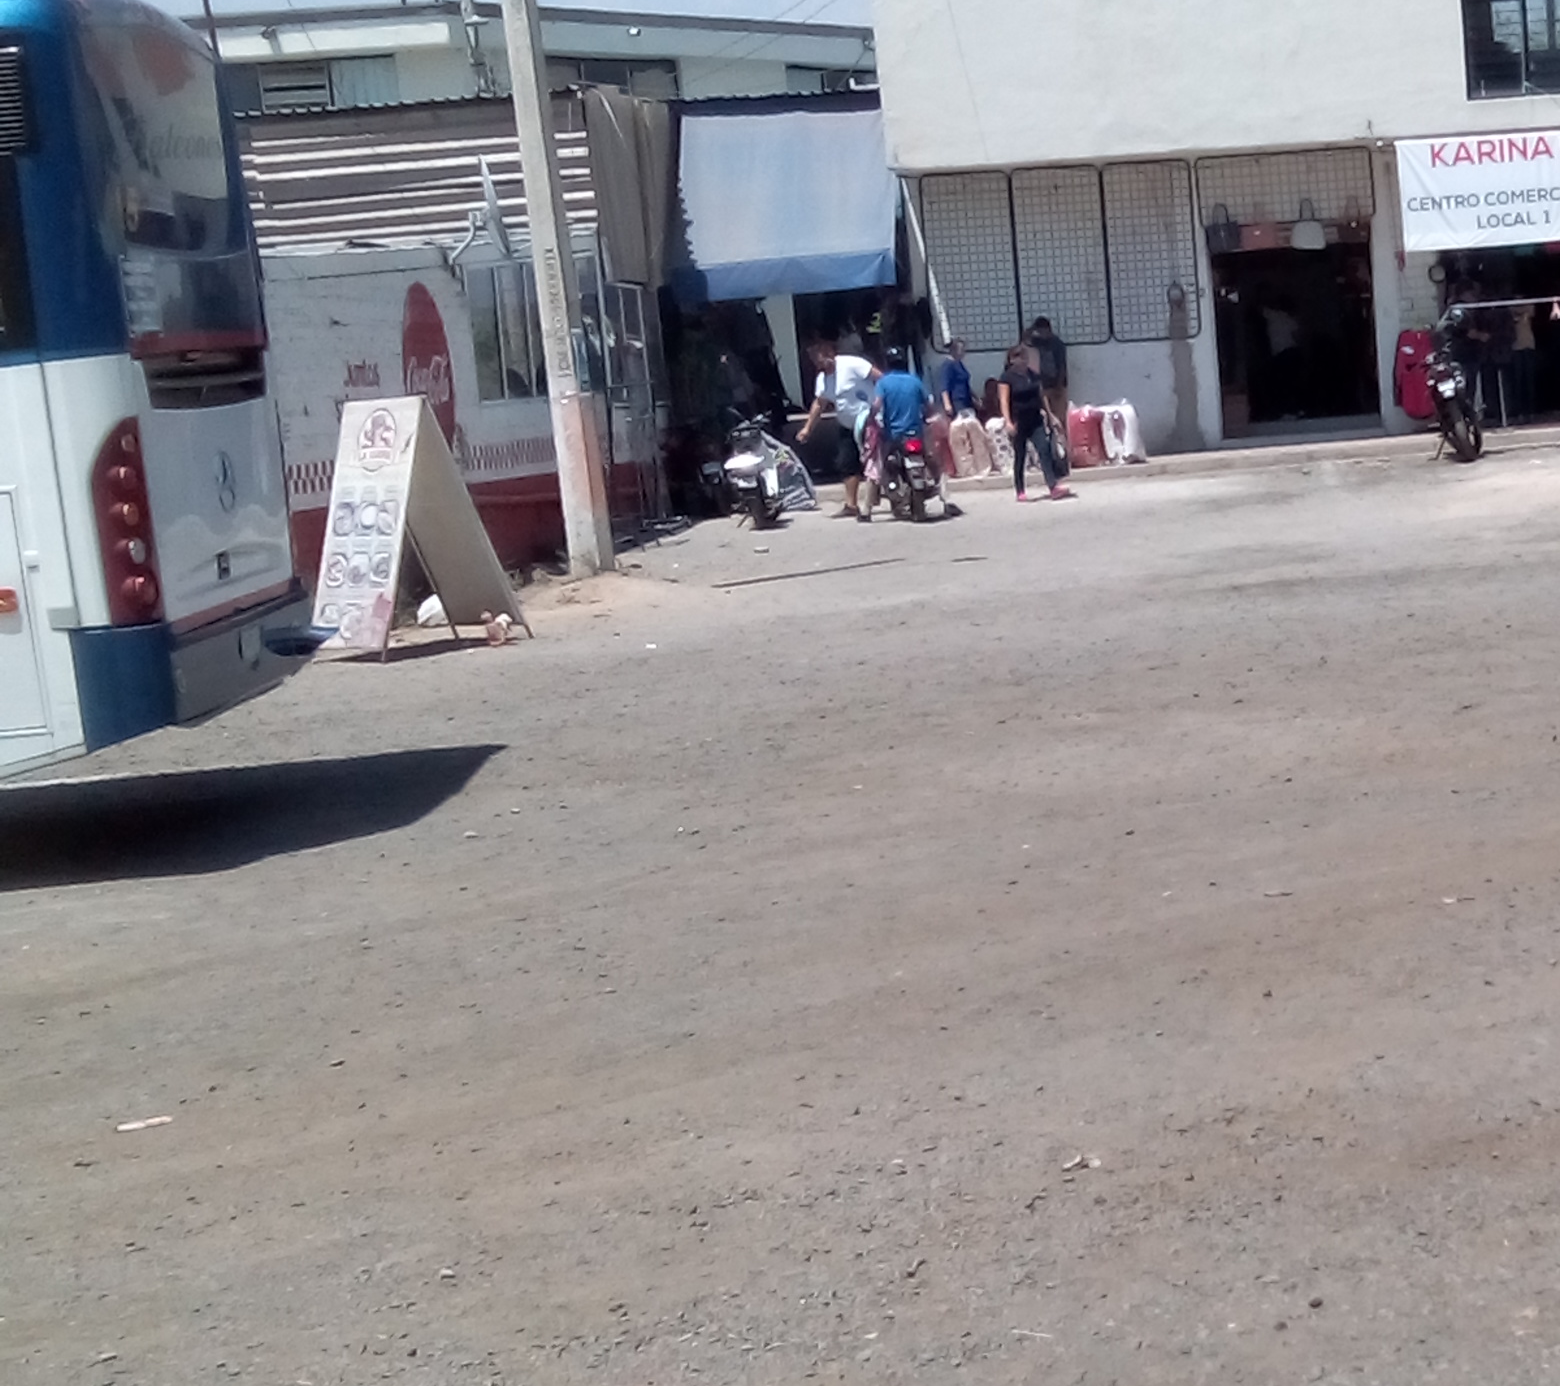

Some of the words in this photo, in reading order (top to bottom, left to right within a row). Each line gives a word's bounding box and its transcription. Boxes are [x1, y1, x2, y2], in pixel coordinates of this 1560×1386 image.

[1430, 136, 1553, 168] KARINA
[1407, 194, 1480, 212] CENTRO
[1476, 213, 1537, 229] LOCAL
[1543, 212, 1551, 225] 1
